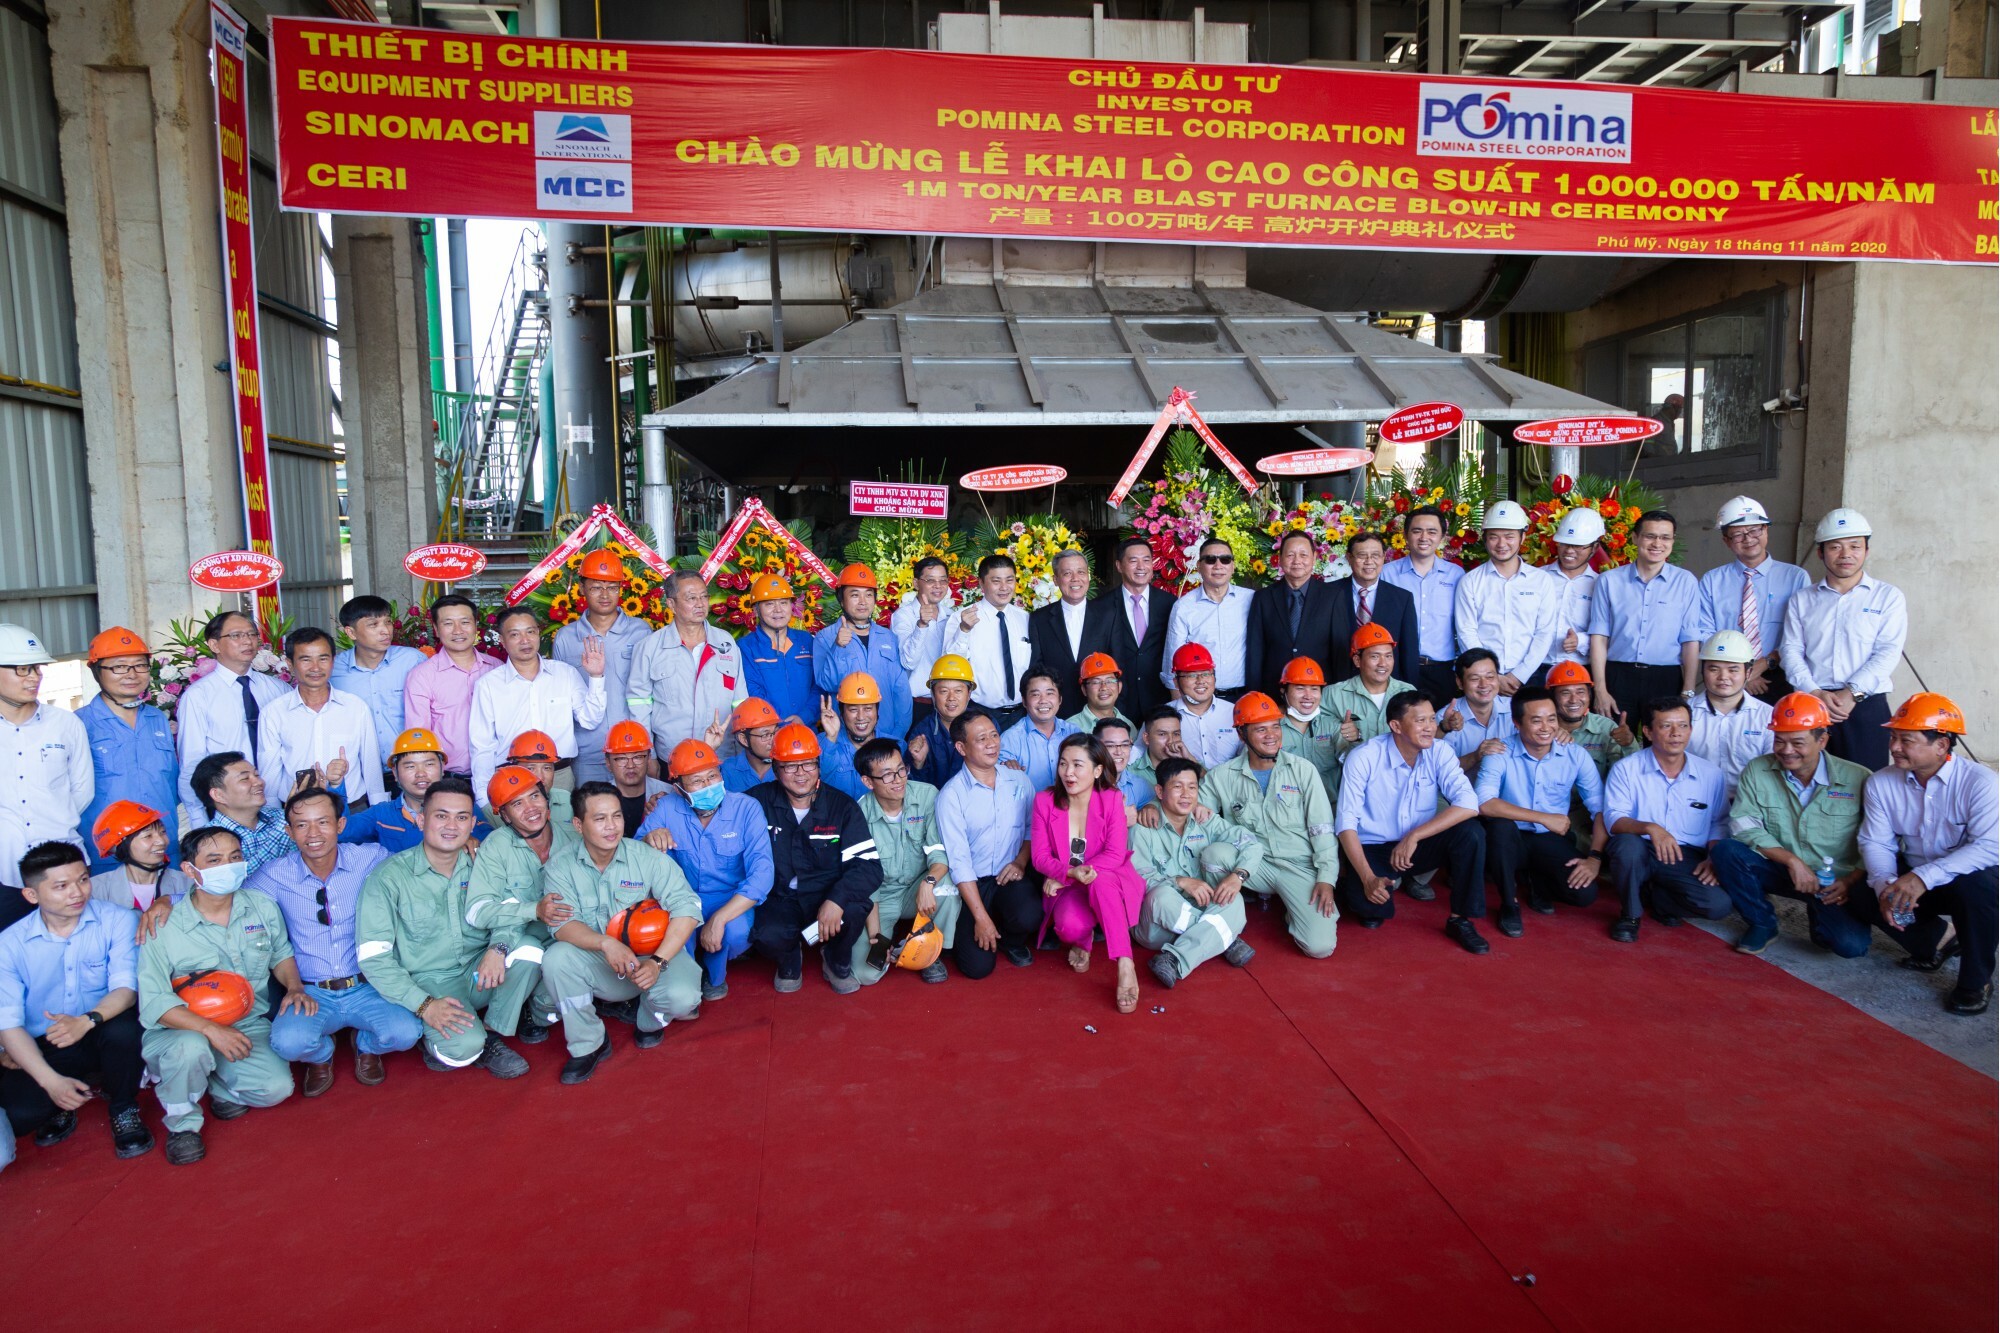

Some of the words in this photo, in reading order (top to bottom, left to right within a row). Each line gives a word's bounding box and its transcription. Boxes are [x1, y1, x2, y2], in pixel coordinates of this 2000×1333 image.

[301, 32, 428, 60] THIẾT
[444, 41, 482, 71] BỊ
[498, 44, 627, 71] CHÍNH
[219, 53, 237, 104] CERI
[299, 70, 470, 98] EQUIPMENT
[480, 80, 633, 107] SUPPLIERS
[1069, 66, 1140, 88] CHỦ
[1152, 68, 1222, 91] ĐẦU
[1234, 75, 1282, 94] TƯ
[1098, 94, 1252, 114] INVESTOR
[306, 111, 528, 144] SINOMACH
[938, 109, 1062, 131] POMINA
[1074, 114, 1172, 136] STEEL
[1183, 119, 1404, 145] CORPORATION
[541, 150, 625, 159] INTERNATIONAL
[1422, 140, 1475, 152] POMINA
[1480, 143, 1522, 154] STEEL
[1527, 145, 1626, 158] CORPORATION
[308, 164, 406, 189] CERI
[676, 136, 800, 166] CHÀO
[816, 141, 942, 171] MỪNG
[960, 142, 1007, 174] LỄ
[1025, 154, 1125, 179] KHAI
[1142, 153, 1192, 181] LÒ
[1207, 160, 1290, 184] CAO
[1303, 160, 1418, 189] CÔNG
[1433, 162, 1539, 193] SUẤT
[1555, 174, 1739, 200] 1.000.000
[1752, 174, 1935, 204] TẤN/NĂM
[544, 177, 625, 198] MCC
[903, 181, 946, 196] 1M
[959, 183, 1122, 203] TON/YEAR
[1134, 189, 1236, 207] BLAST
[1251, 192, 1397, 213] FURNACE
[1408, 198, 1540, 217] BLOW-IN
[1551, 202, 1728, 222] CEREMONY
[1264, 214, 1515, 241] 高炉开炉典礼仪式
[1598, 236, 1628, 247] Phú
[1668, 238, 1708, 251] Ngày
[1716, 240, 1732, 249] 18
[1737, 240, 1782, 253] tháng
[1790, 242, 1804, 250] 11
[1811, 241, 1845, 252] năm
[1851, 242, 1887, 253] 2020
[230, 248, 238, 279] a
[1404, 427, 1422, 438] KHAI
[1424, 424, 1435, 434] LÒ
[1437, 422, 1452, 430] CAO
[854, 496, 872, 504] THAN
[867, 488, 884, 496] TNHH
[886, 488, 899, 496] MTV
[900, 489, 908, 497] SX
[210, 566, 233, 578] Chúc
[234, 565, 262, 578] Mừng
